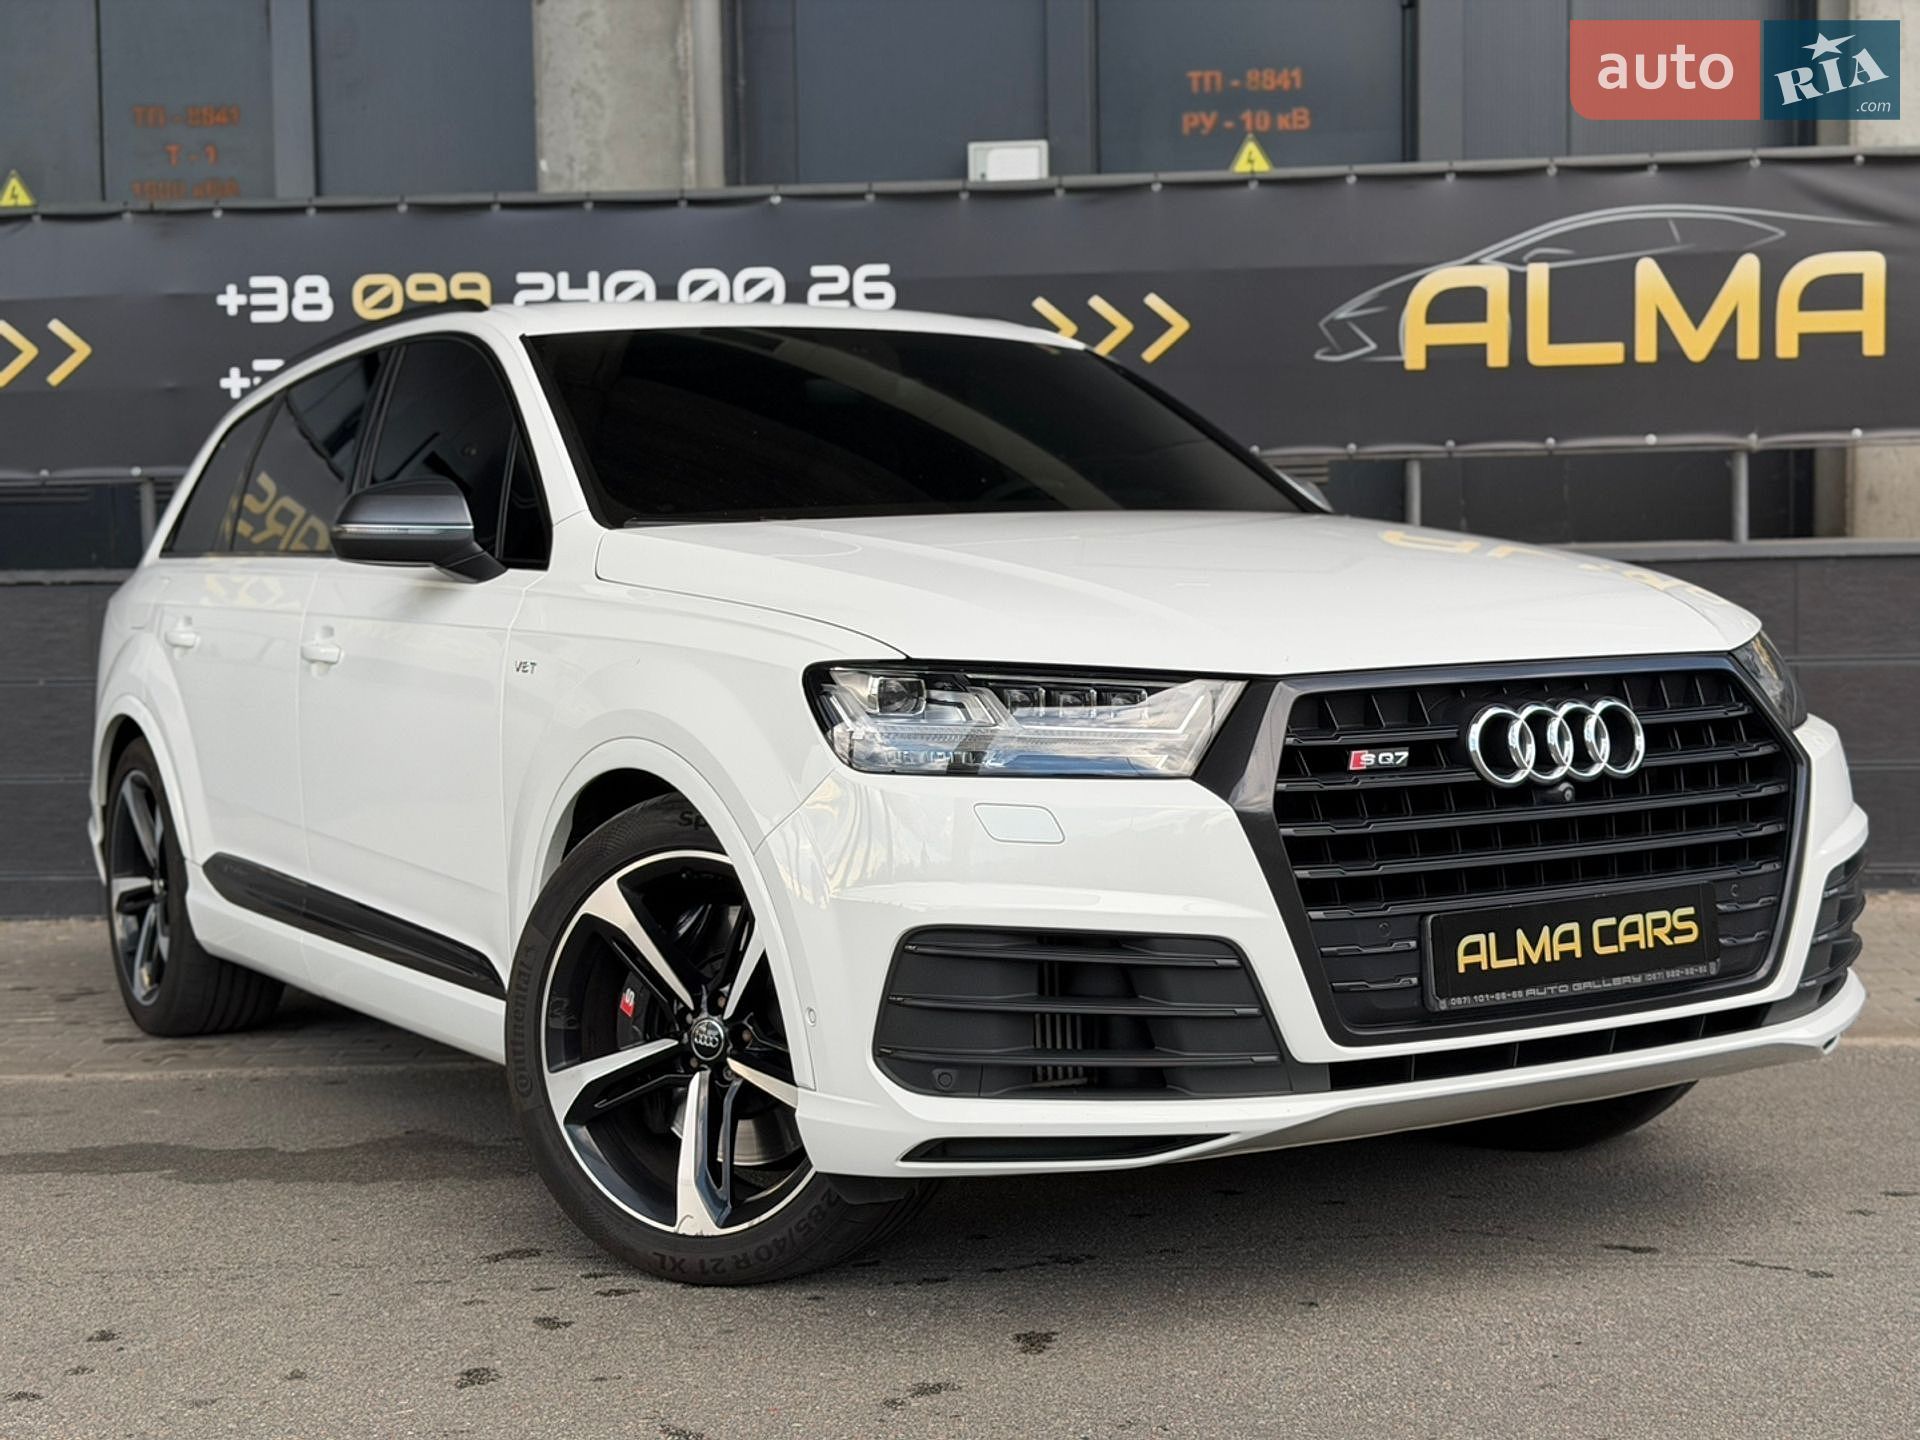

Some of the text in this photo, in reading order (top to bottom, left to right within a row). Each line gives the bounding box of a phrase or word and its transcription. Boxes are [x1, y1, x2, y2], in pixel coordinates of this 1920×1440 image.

[1241, 111, 1272, 132] 10
[216, 275, 334, 323] +38
[807, 263, 896, 310] 26
[1403, 250, 1887, 370] ALMA
[1456, 906, 1700, 974] ALMA CARS
[1525, 984, 1570, 997] AUTO
[1572, 974, 1642, 991] GALLERY
